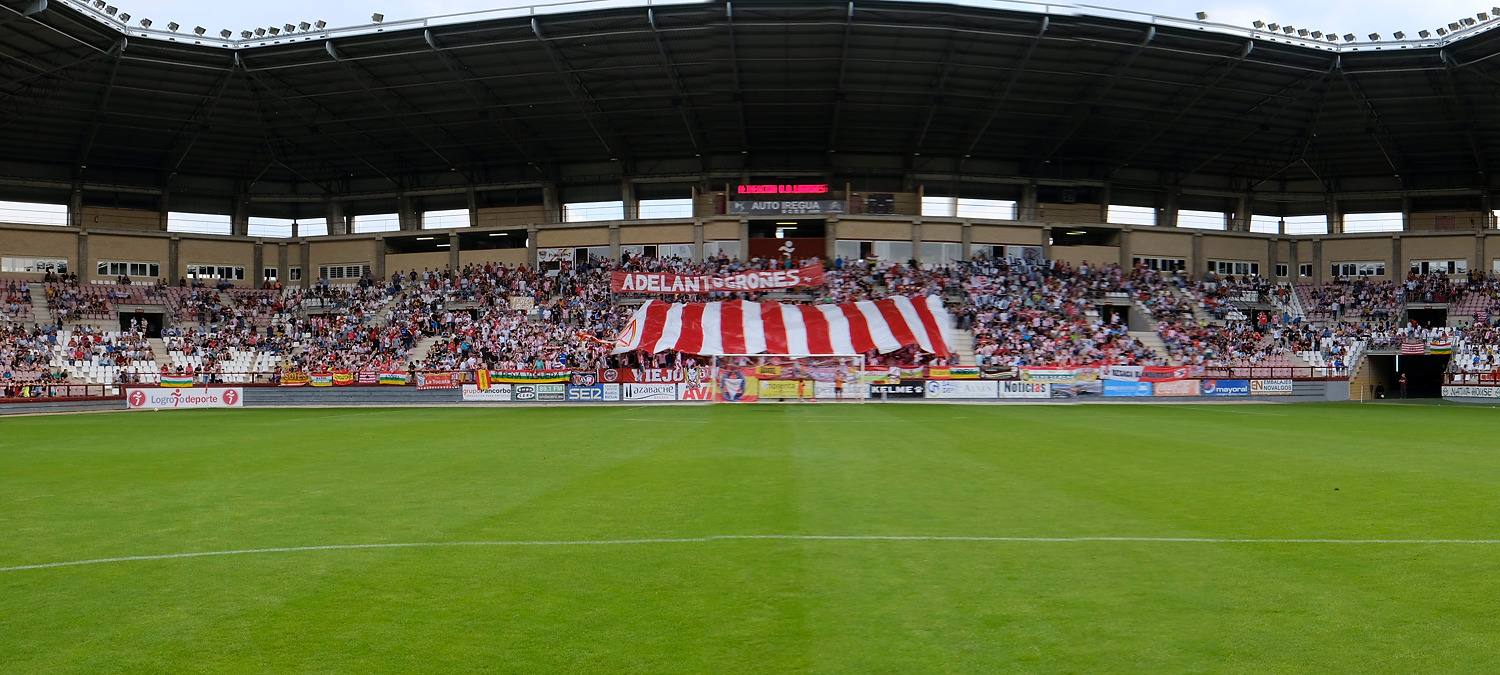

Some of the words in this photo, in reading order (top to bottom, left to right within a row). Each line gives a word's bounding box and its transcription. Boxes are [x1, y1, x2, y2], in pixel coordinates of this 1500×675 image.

[751, 201, 780, 210] AUTO
[781, 201, 820, 210] IREGUA
[871, 386, 914, 394] KELME
[1004, 381, 1046, 393] Noticias
[569, 388, 602, 399] SER
